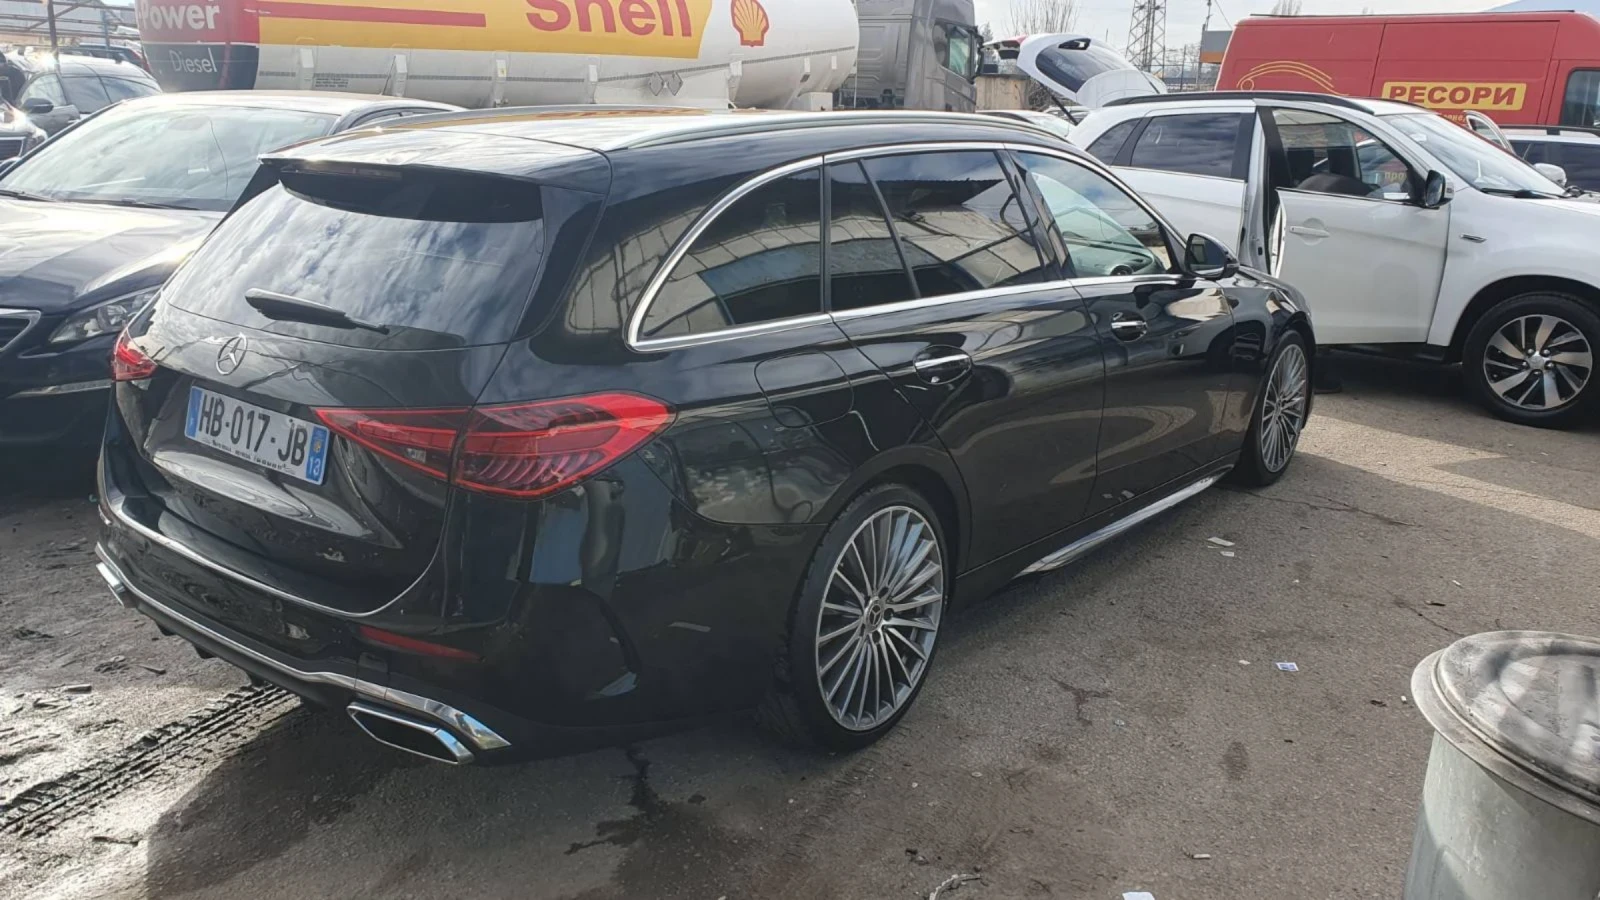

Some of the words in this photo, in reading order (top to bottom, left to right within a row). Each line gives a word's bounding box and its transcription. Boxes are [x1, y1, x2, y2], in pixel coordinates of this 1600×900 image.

[140, 0, 220, 30] Power
[526, 0, 692, 37] Shell
[169, 47, 217, 73] Diesel
[1389, 86, 1517, 106] РЕСОРИ
[308, 455, 321, 477] 13
